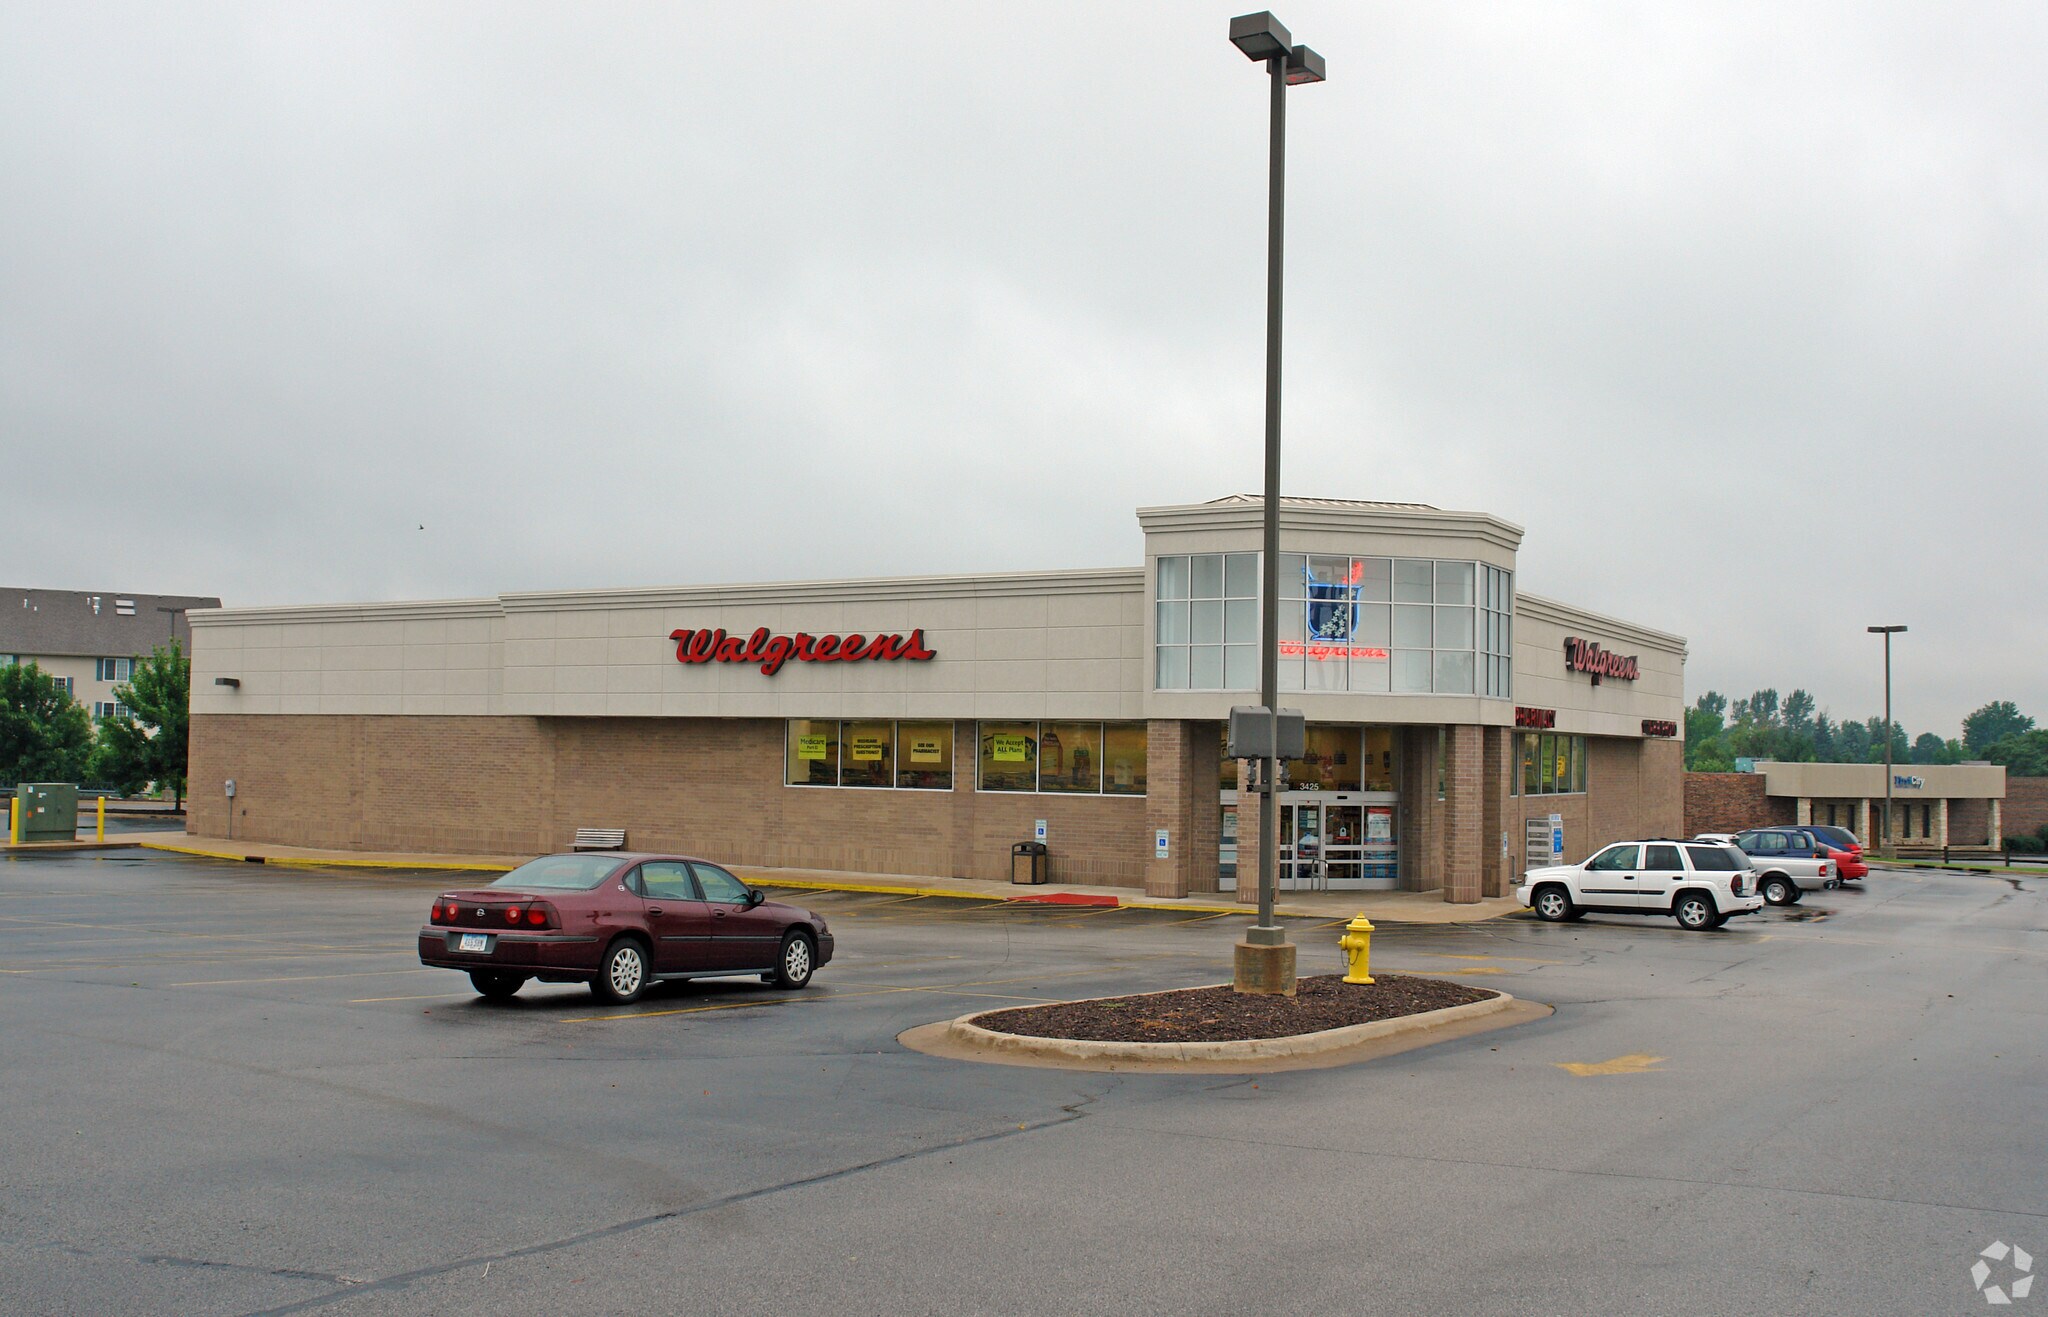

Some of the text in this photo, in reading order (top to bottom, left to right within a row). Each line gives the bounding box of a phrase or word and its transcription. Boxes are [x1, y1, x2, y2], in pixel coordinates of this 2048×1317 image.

[669, 627, 937, 676] Walgreens
[1278, 641, 1389, 661] Walgreens
[1564, 636, 1640, 687] Walgreens
[1005, 739, 1024, 748] Accept
[1299, 782, 1319, 791] 3425
